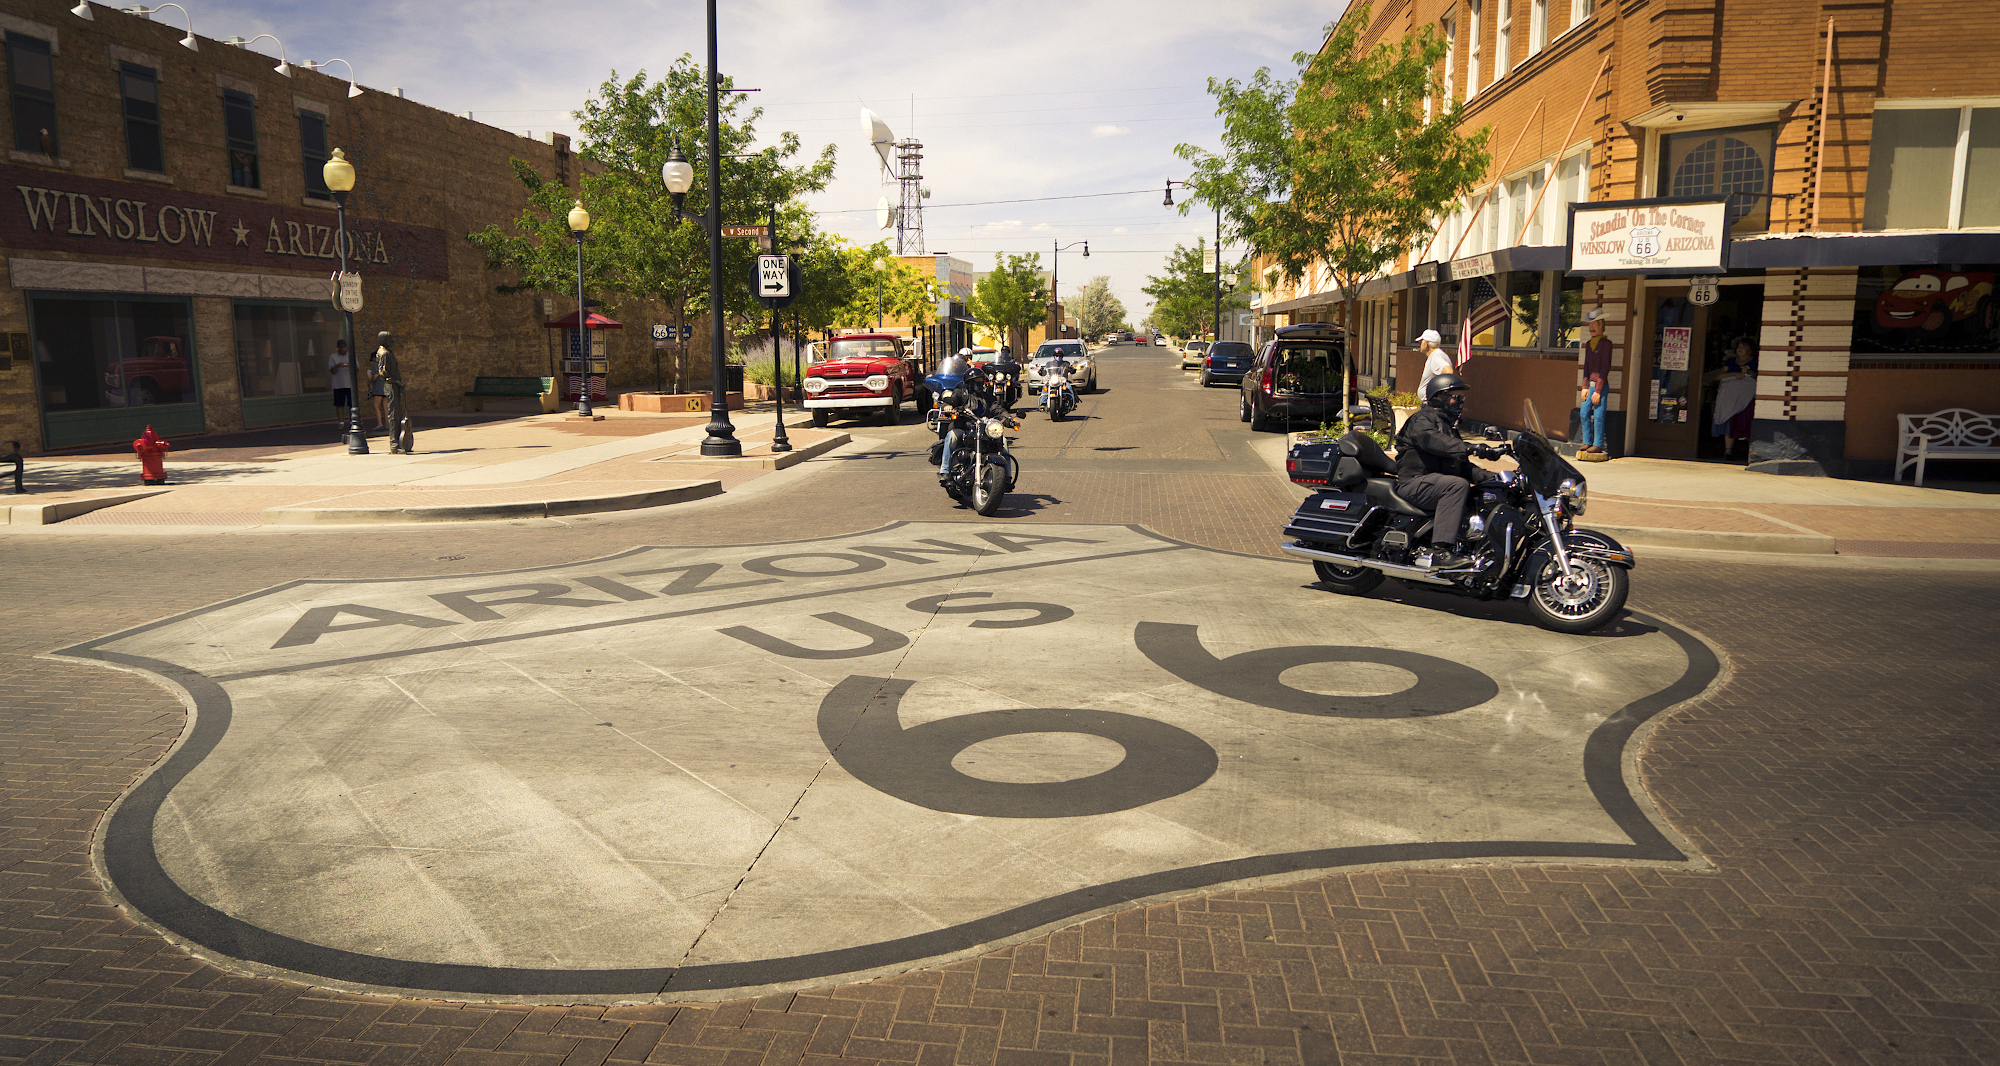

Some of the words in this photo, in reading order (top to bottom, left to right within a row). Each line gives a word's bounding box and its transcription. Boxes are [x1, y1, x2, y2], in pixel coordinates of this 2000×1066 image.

[16, 185, 218, 247] WINSLOW
[264, 216, 389, 264] ARIZONA
[1590, 208, 1629, 241] Standin'
[1631, 208, 1646, 226] On
[1649, 207, 1667, 226] The
[1670, 208, 1706, 235] Corner
[737, 227, 759, 236] Second
[1579, 240, 1626, 255] WINSLOW
[1636, 243, 1651, 254] 66
[1665, 236, 1715, 252] ARIZONA
[763, 259, 785, 269] ONE
[762, 270, 785, 280] WAY
[1695, 291, 1710, 301] 66
[655, 329, 666, 338] 66
[270, 531, 1108, 650] ARIZONA
[817, 620, 1499, 819] 66
